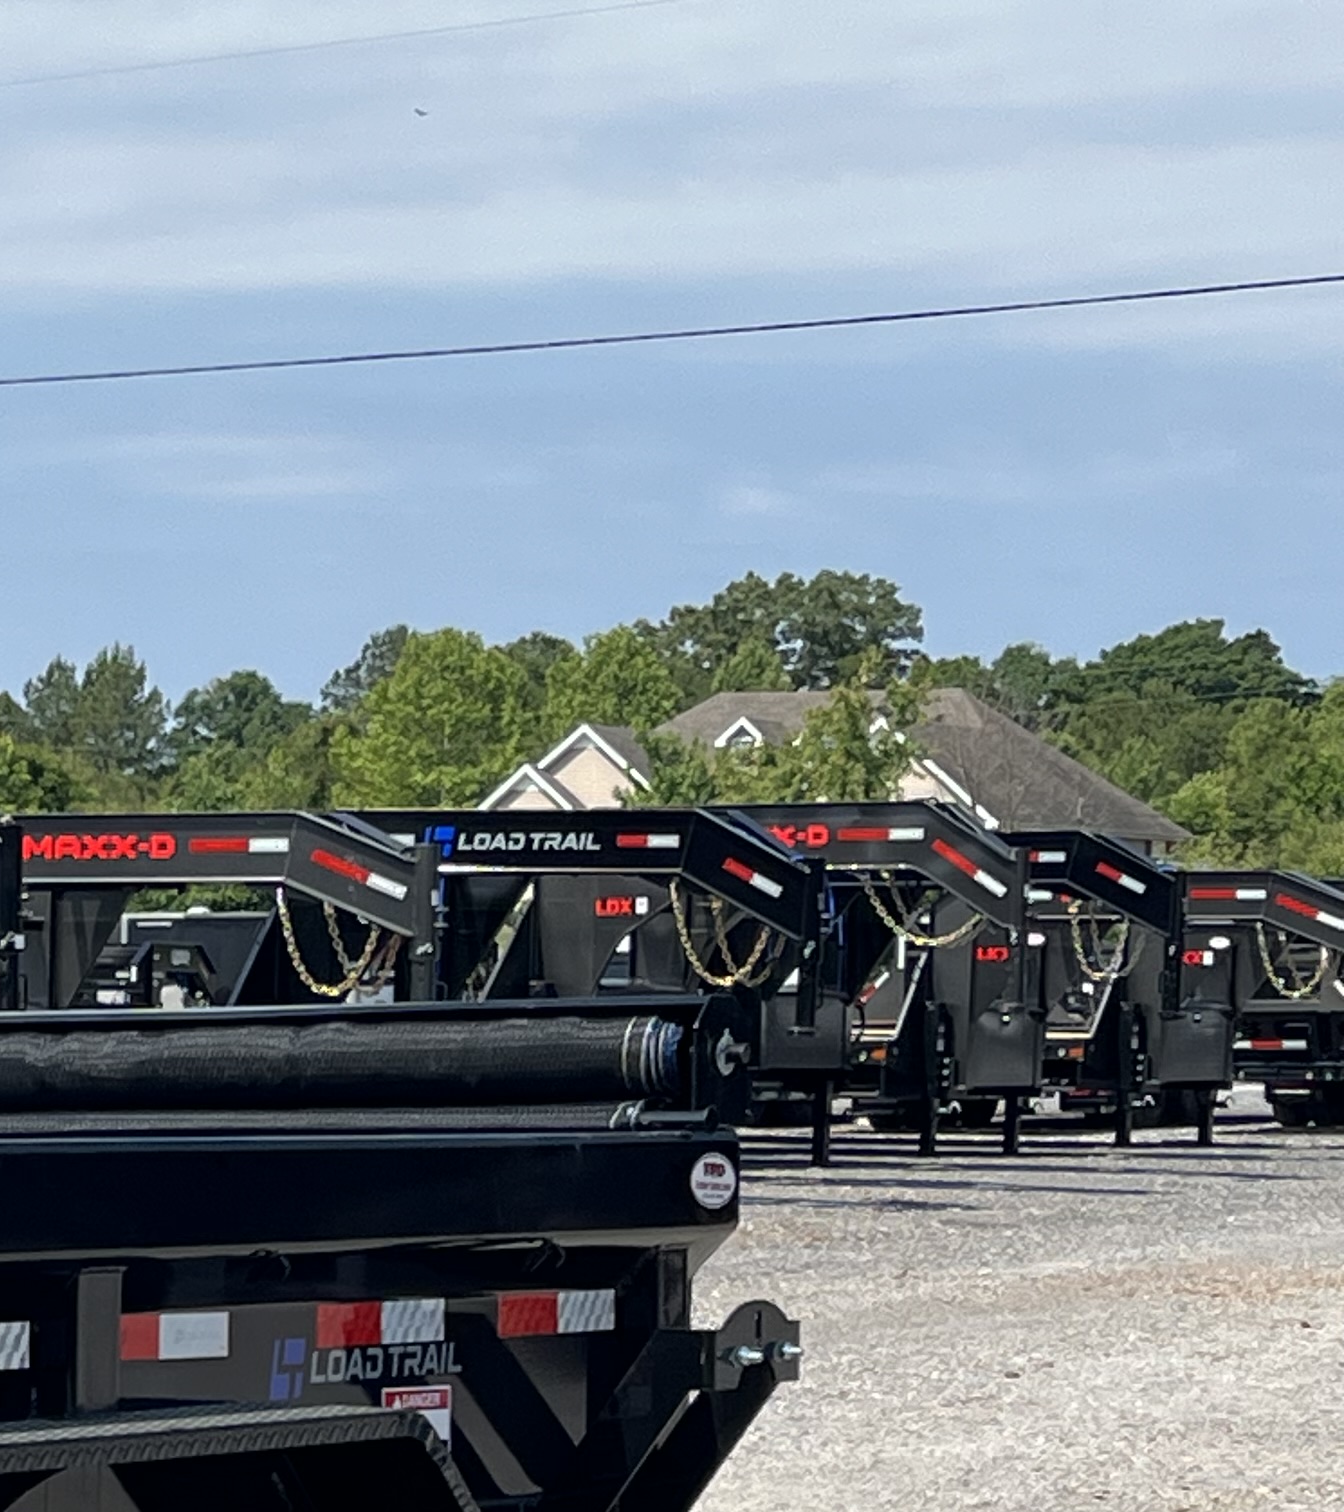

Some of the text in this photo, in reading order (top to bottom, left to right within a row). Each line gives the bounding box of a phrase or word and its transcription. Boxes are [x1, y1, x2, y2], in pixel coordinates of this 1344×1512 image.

[21, 834, 177, 861] MAXX-D
[457, 831, 602, 851] LOAD TRAIL
[594, 897, 633, 917] LDX
[310, 1341, 463, 1385] LOAD TRAIL
